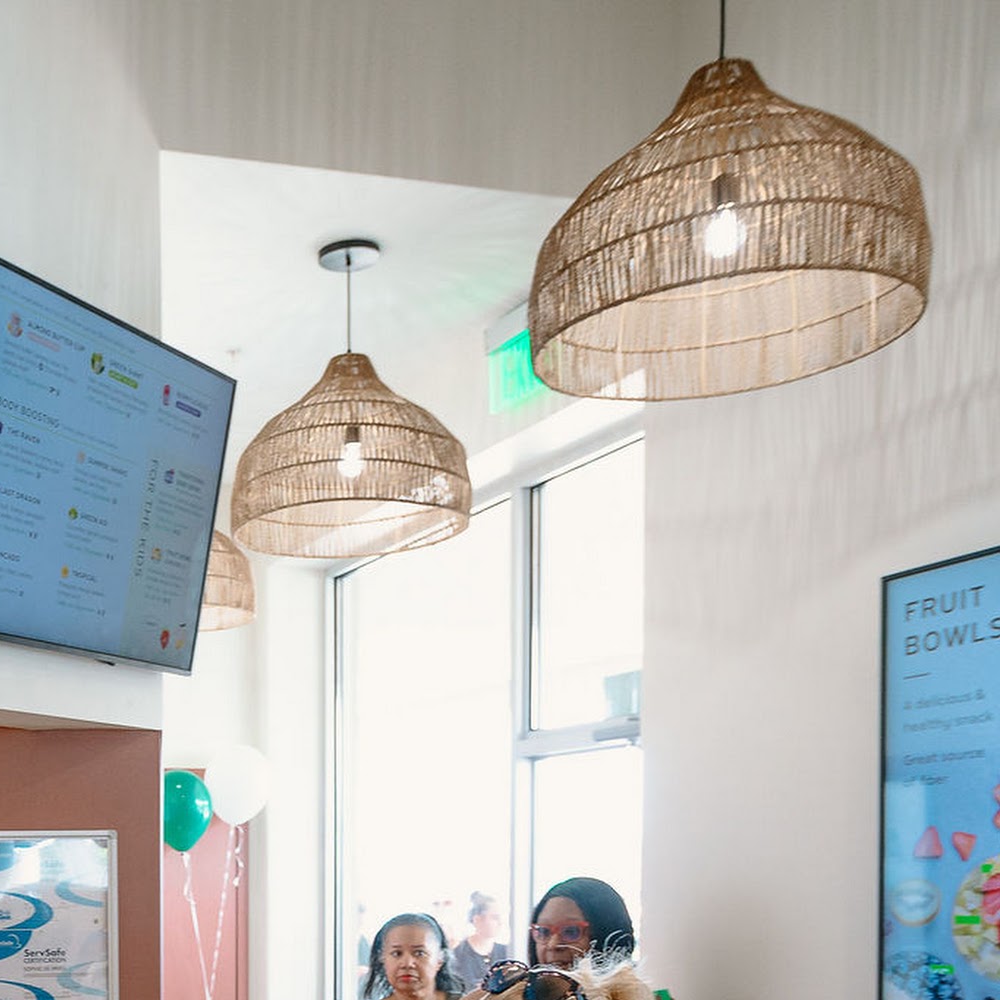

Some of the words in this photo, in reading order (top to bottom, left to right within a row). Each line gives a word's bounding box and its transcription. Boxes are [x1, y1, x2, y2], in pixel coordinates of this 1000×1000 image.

[904, 585, 985, 622] FRUIT
[904, 616, 1000, 656] BOWLS
[23, 948, 67, 957] ServSafe
